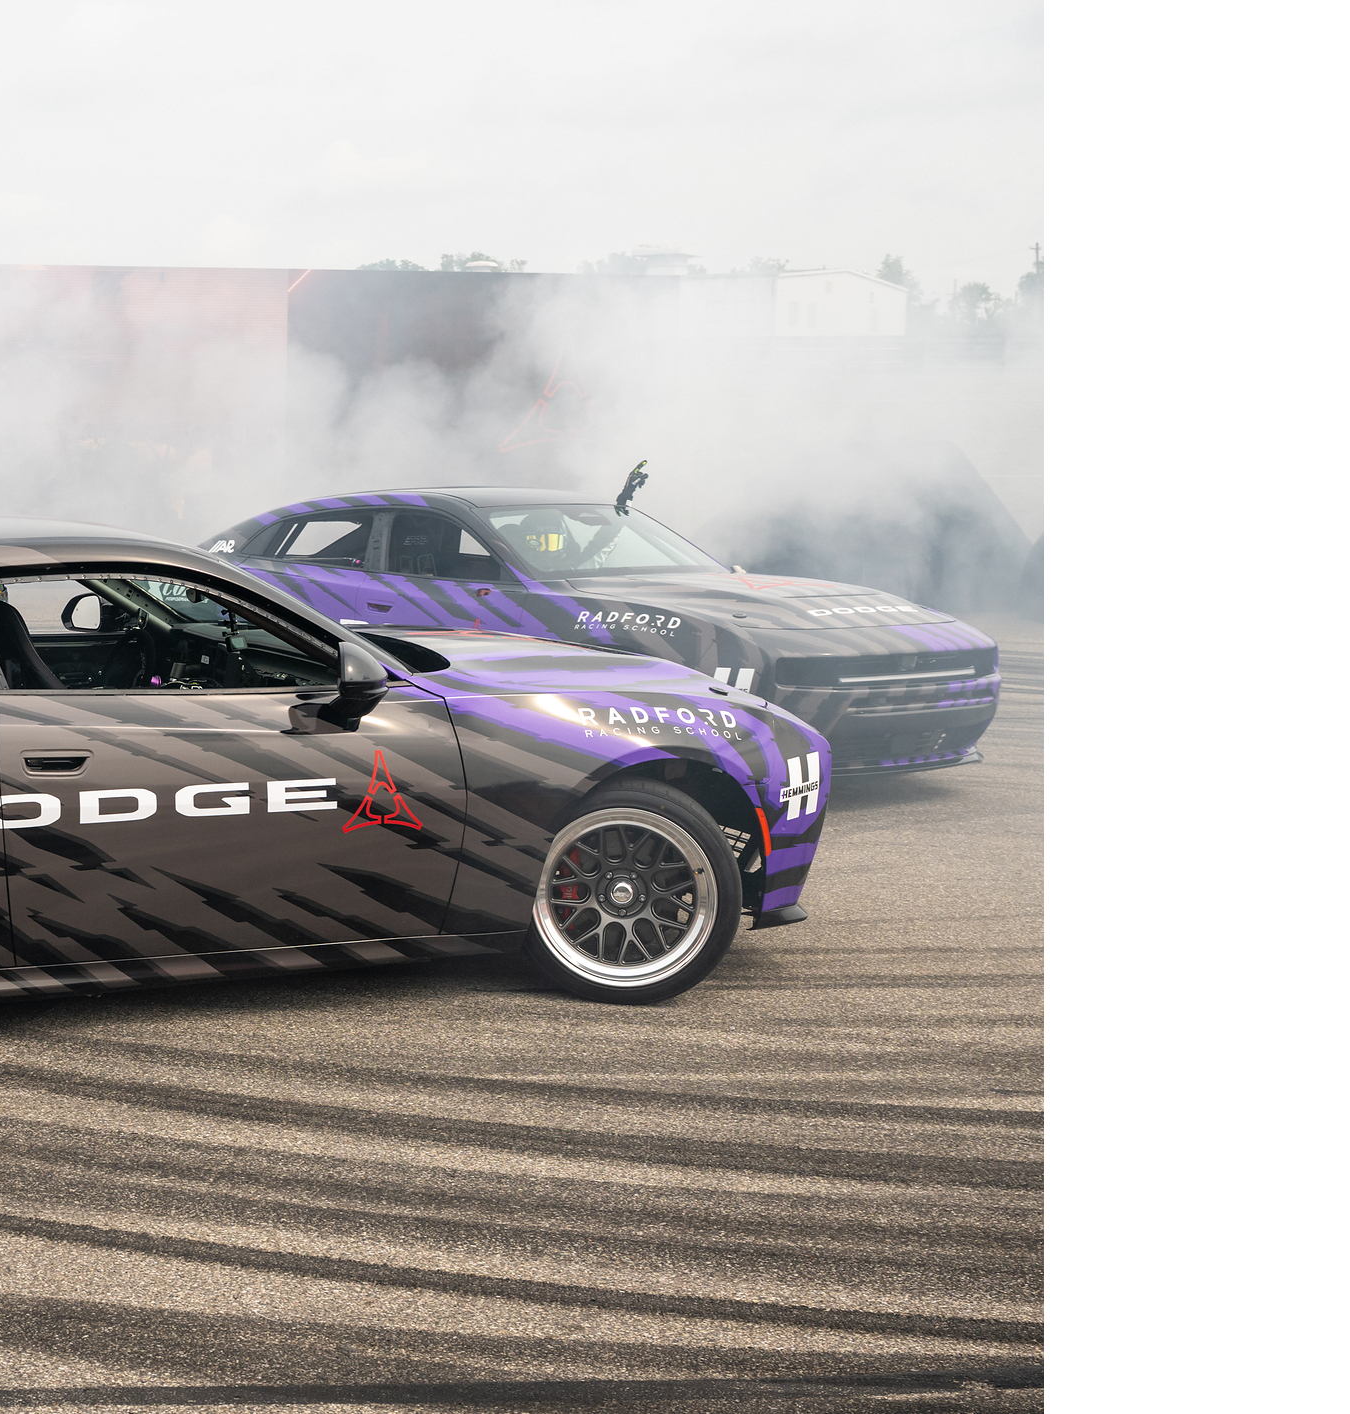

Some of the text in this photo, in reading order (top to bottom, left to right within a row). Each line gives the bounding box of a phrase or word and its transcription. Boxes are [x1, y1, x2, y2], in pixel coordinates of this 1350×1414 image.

[806, 605, 919, 617] DODGE
[577, 611, 681, 629] RADFORD
[623, 624, 675, 637] SCHOOL
[577, 707, 737, 728] RADFORD
[584, 726, 742, 741] RACING SCHOOL
[781, 781, 818, 799] HEMMINGS
